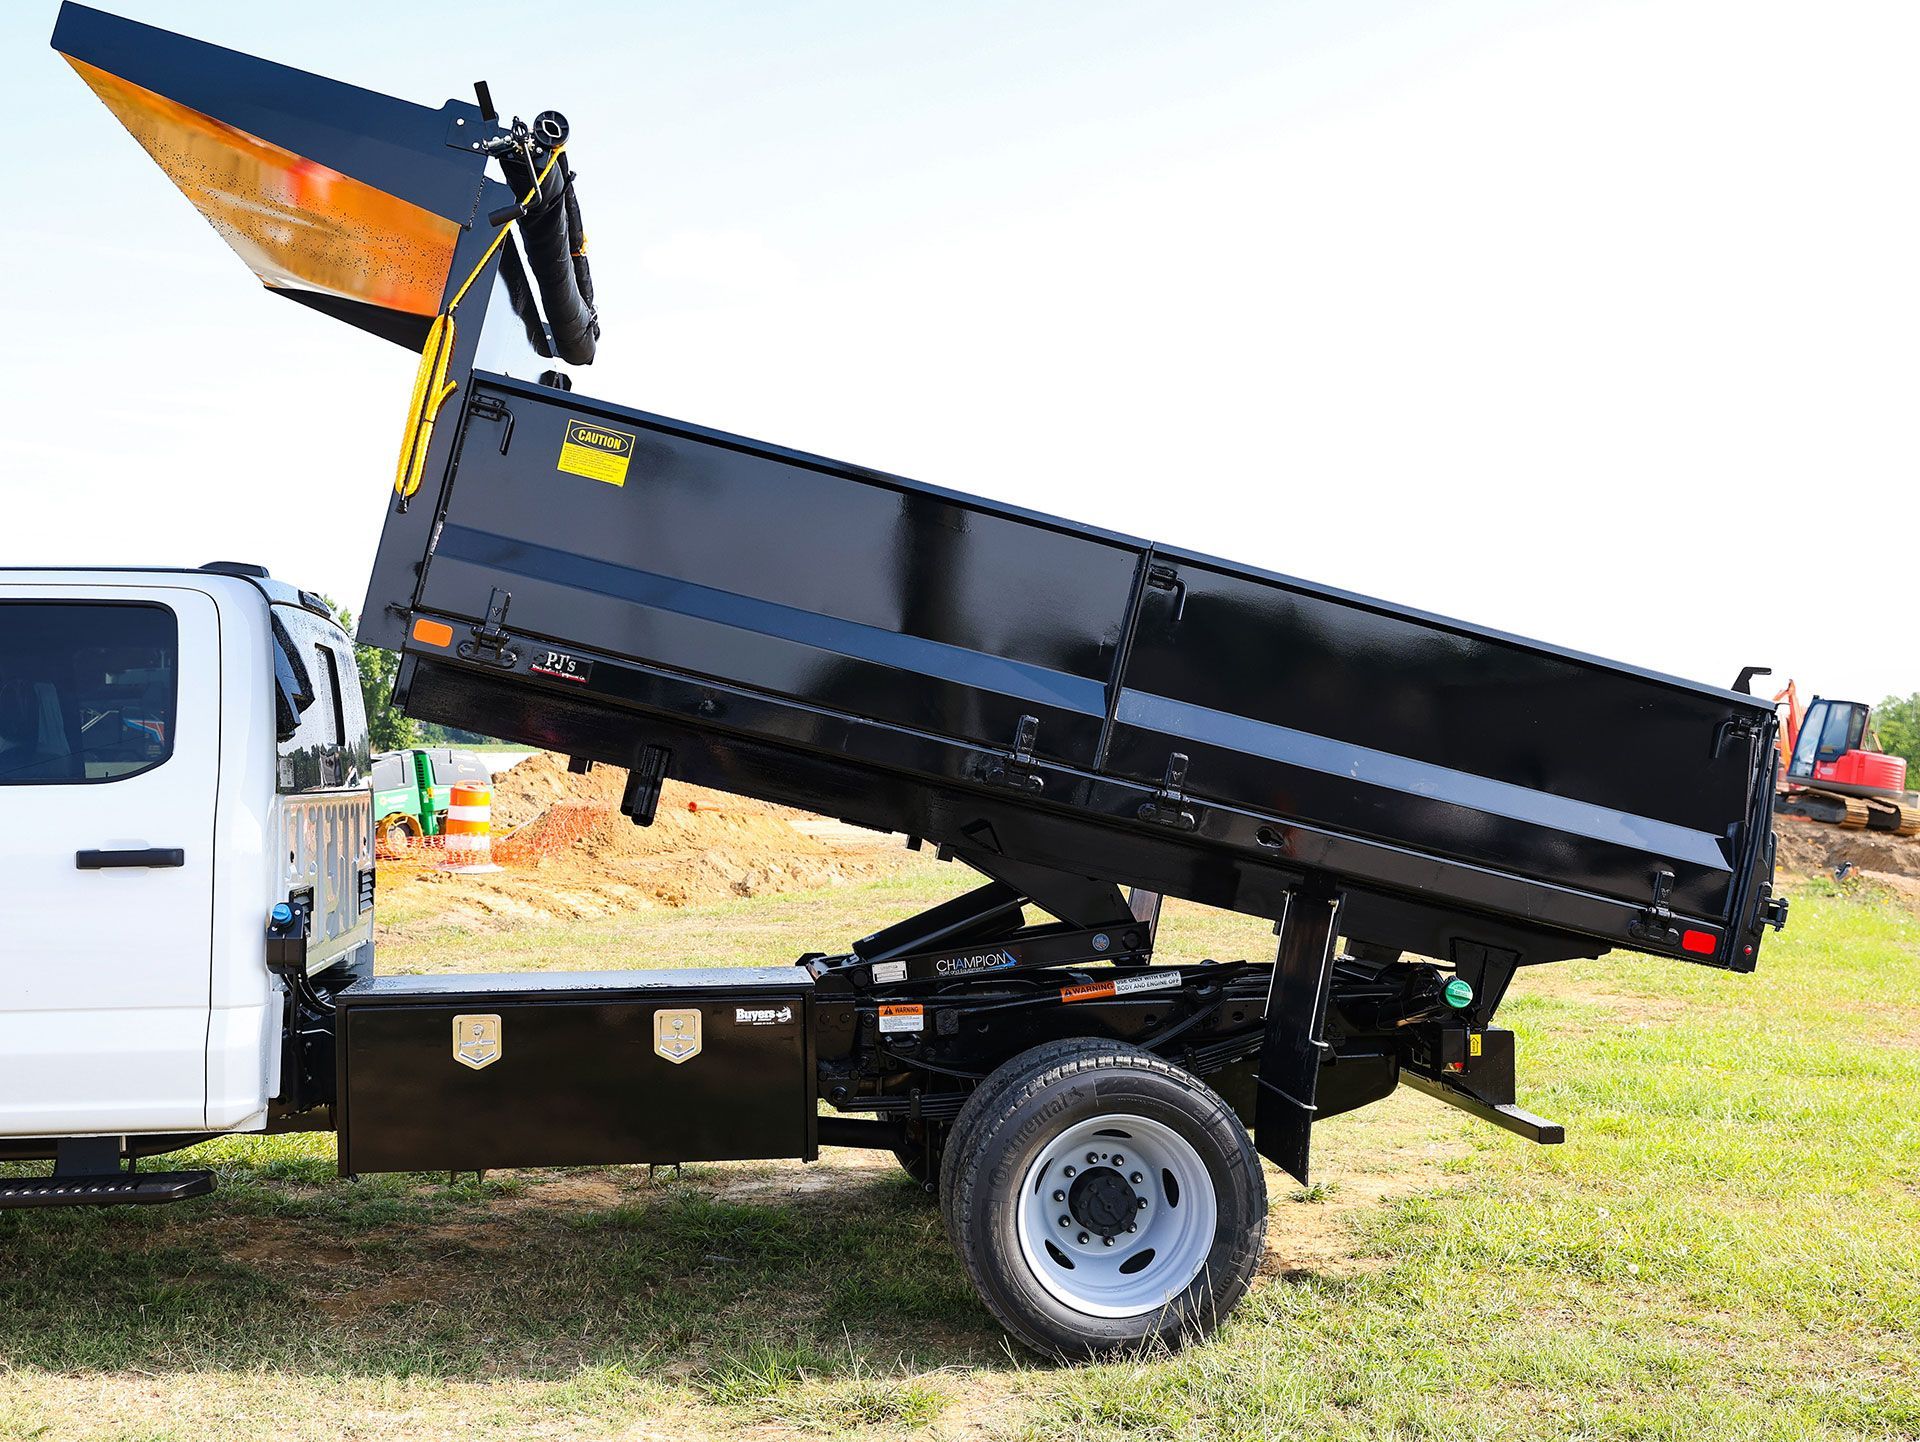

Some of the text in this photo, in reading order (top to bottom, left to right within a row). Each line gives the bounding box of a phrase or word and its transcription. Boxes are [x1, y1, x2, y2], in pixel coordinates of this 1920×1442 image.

[578, 430, 622, 450] CAUTION
[545, 651, 576, 672] PJ's
[936, 953, 1006, 973] CHAMPION
[1159, 971, 1178, 979] EMPTY
[1072, 982, 1114, 996] WARNING
[1117, 984, 1133, 992] BODY
[1134, 982, 1146, 990] AND
[1147, 980, 1168, 988] ENGINE
[736, 1008, 775, 1021] Buyers
[895, 1006, 919, 1014] WARNING
[988, 1092, 1069, 1190] Continental
